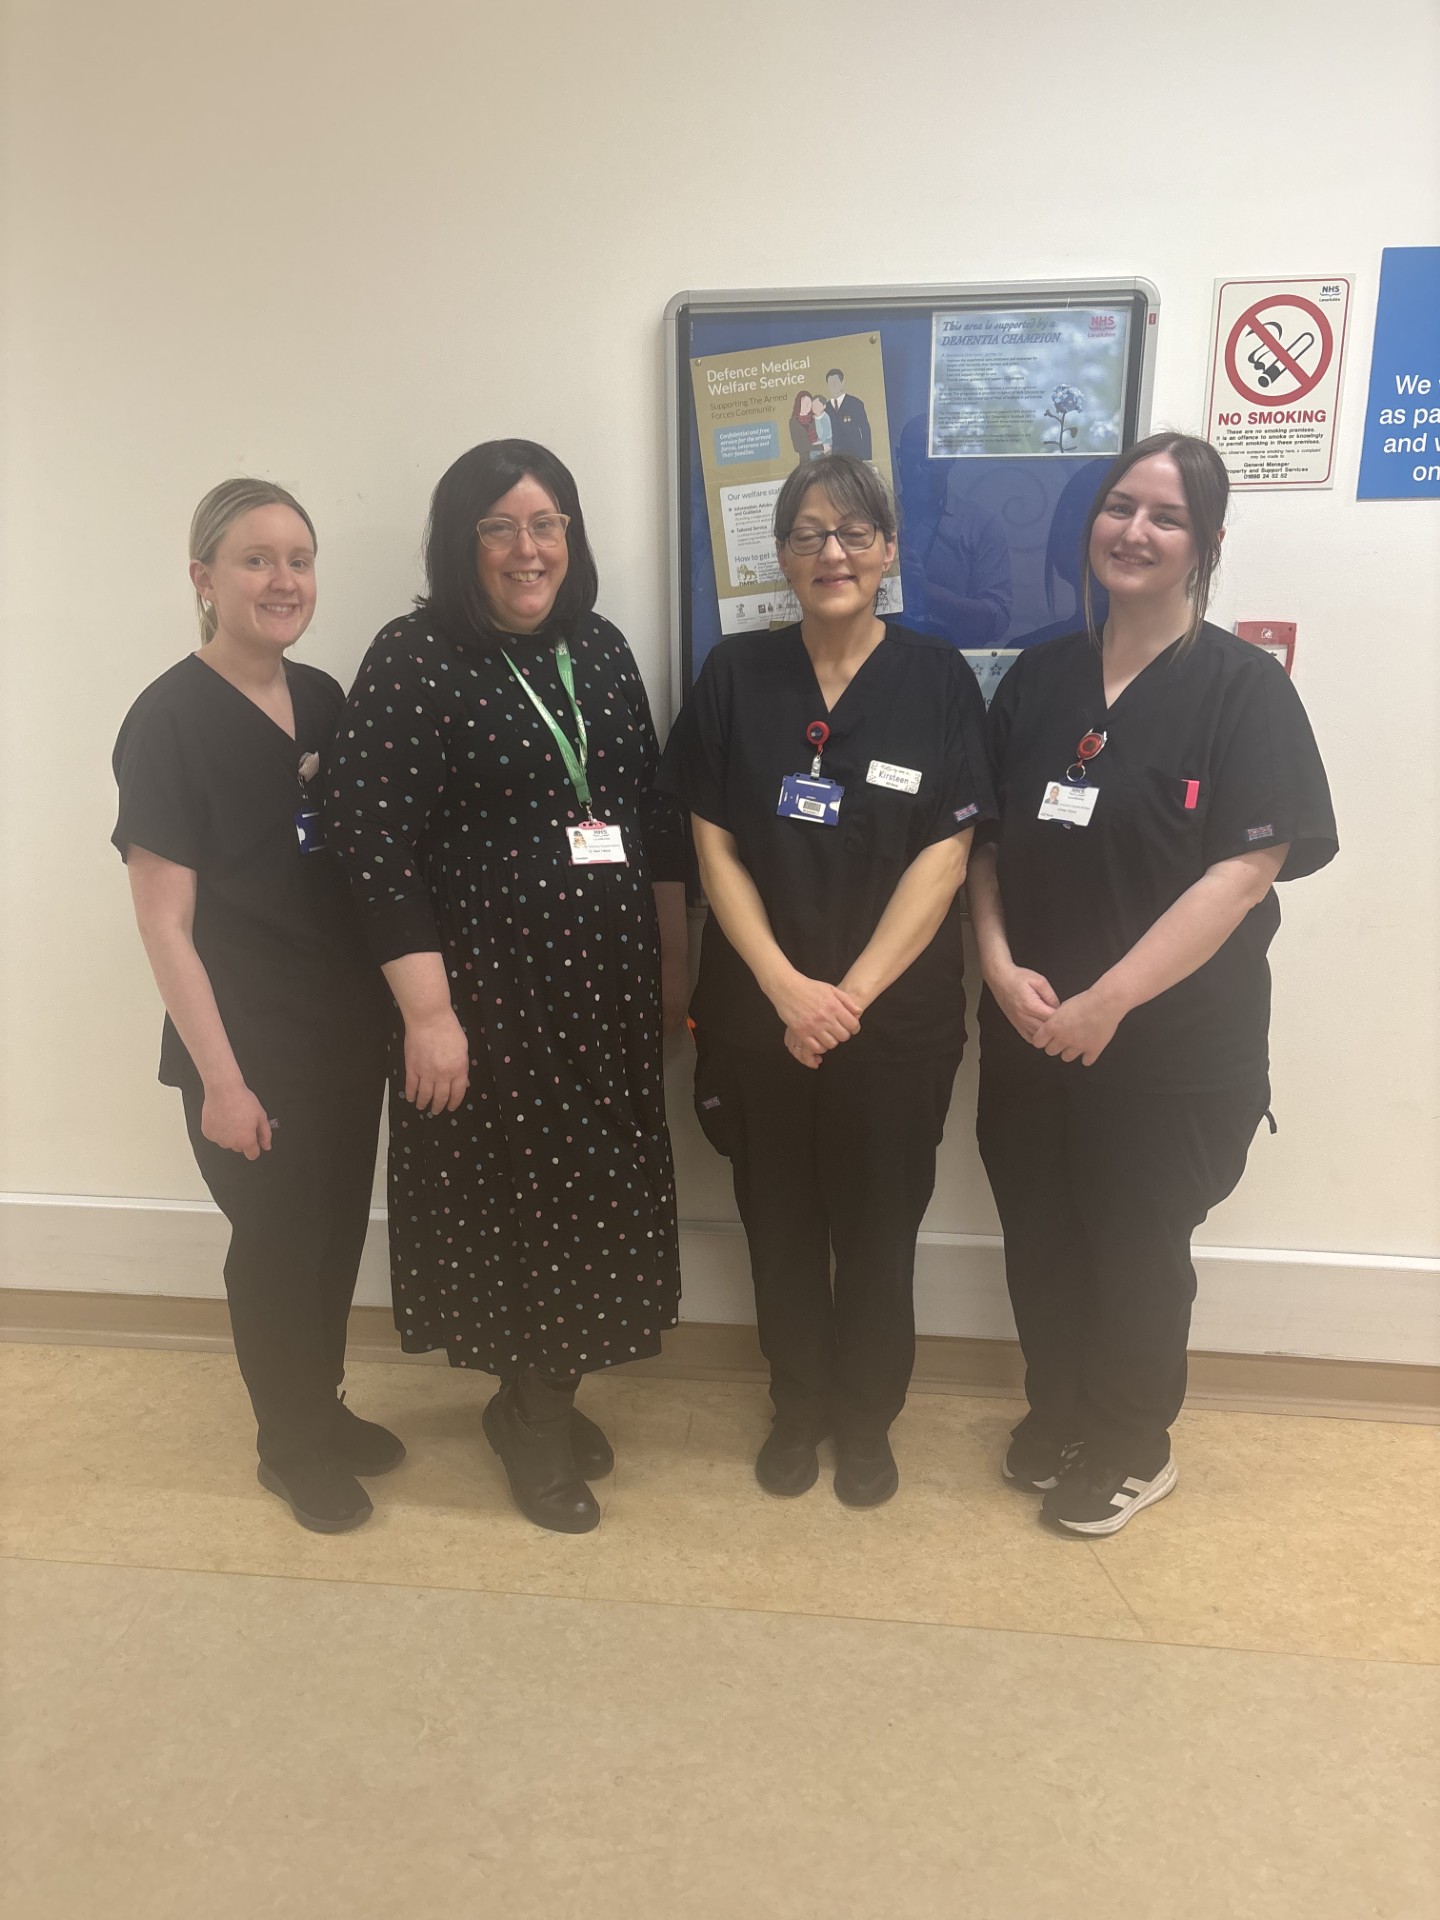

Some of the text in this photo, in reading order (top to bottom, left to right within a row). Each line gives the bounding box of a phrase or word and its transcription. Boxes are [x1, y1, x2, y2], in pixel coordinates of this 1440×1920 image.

[942, 322, 962, 332] This
[964, 322, 982, 330] area
[986, 320, 993, 330] is
[994, 318, 1035, 333] supported
[1037, 318, 1048, 332] by
[1091, 316, 1115, 326] NHS
[942, 333, 1062, 346] DEMENTIA CHAMPION
[706, 356, 811, 383] Defence Medical
[708, 374, 805, 396] Welfare Service
[1396, 374, 1431, 394] We
[710, 393, 788, 412] Supporting The Armed
[712, 405, 776, 420] Forces Community
[1218, 410, 1326, 426] NO SMOKING
[1380, 408, 1406, 424] as
[1384, 433, 1427, 453] and
[742, 490, 767, 499] welfare
[879, 770, 909, 784] Kirsteen
